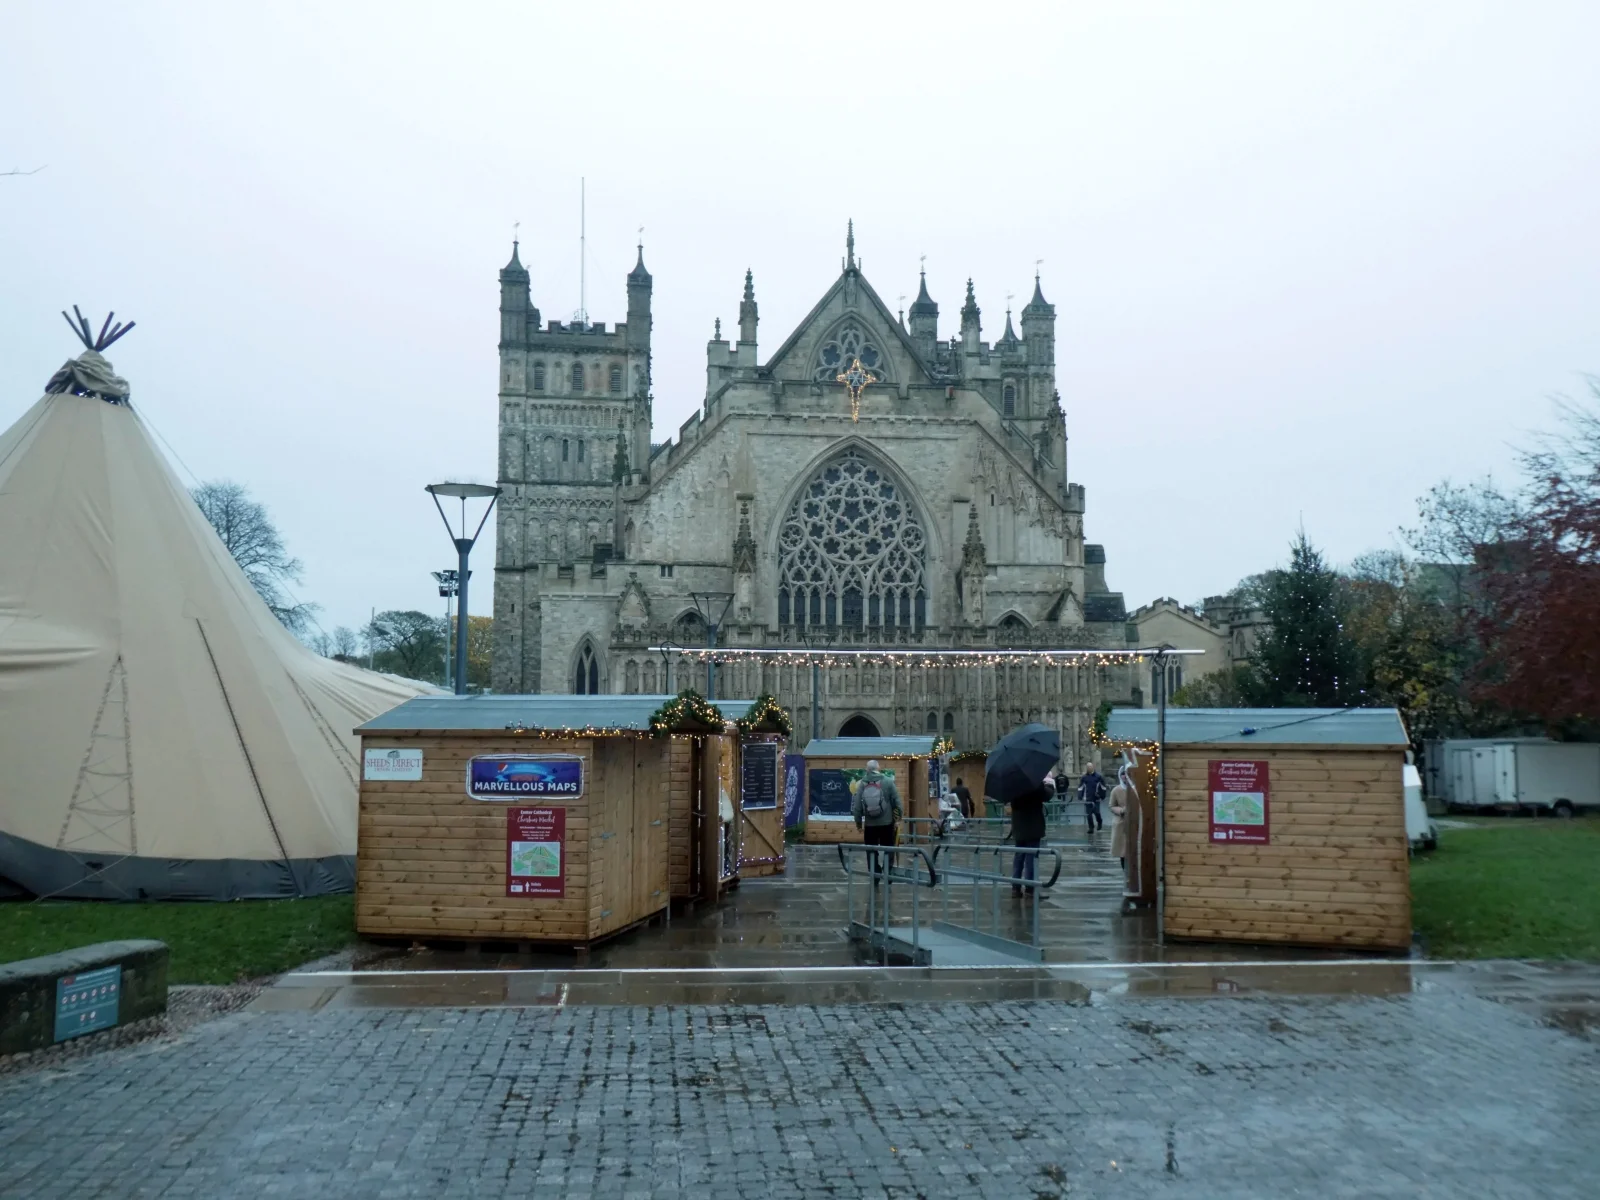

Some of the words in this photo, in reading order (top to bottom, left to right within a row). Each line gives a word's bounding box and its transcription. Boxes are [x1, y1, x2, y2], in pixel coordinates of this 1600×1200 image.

[366, 758, 390, 768] SHEDS
[392, 758, 421, 768] DIRECT
[474, 781, 544, 791] MARVELLOUS
[547, 782, 577, 791] MAPS
